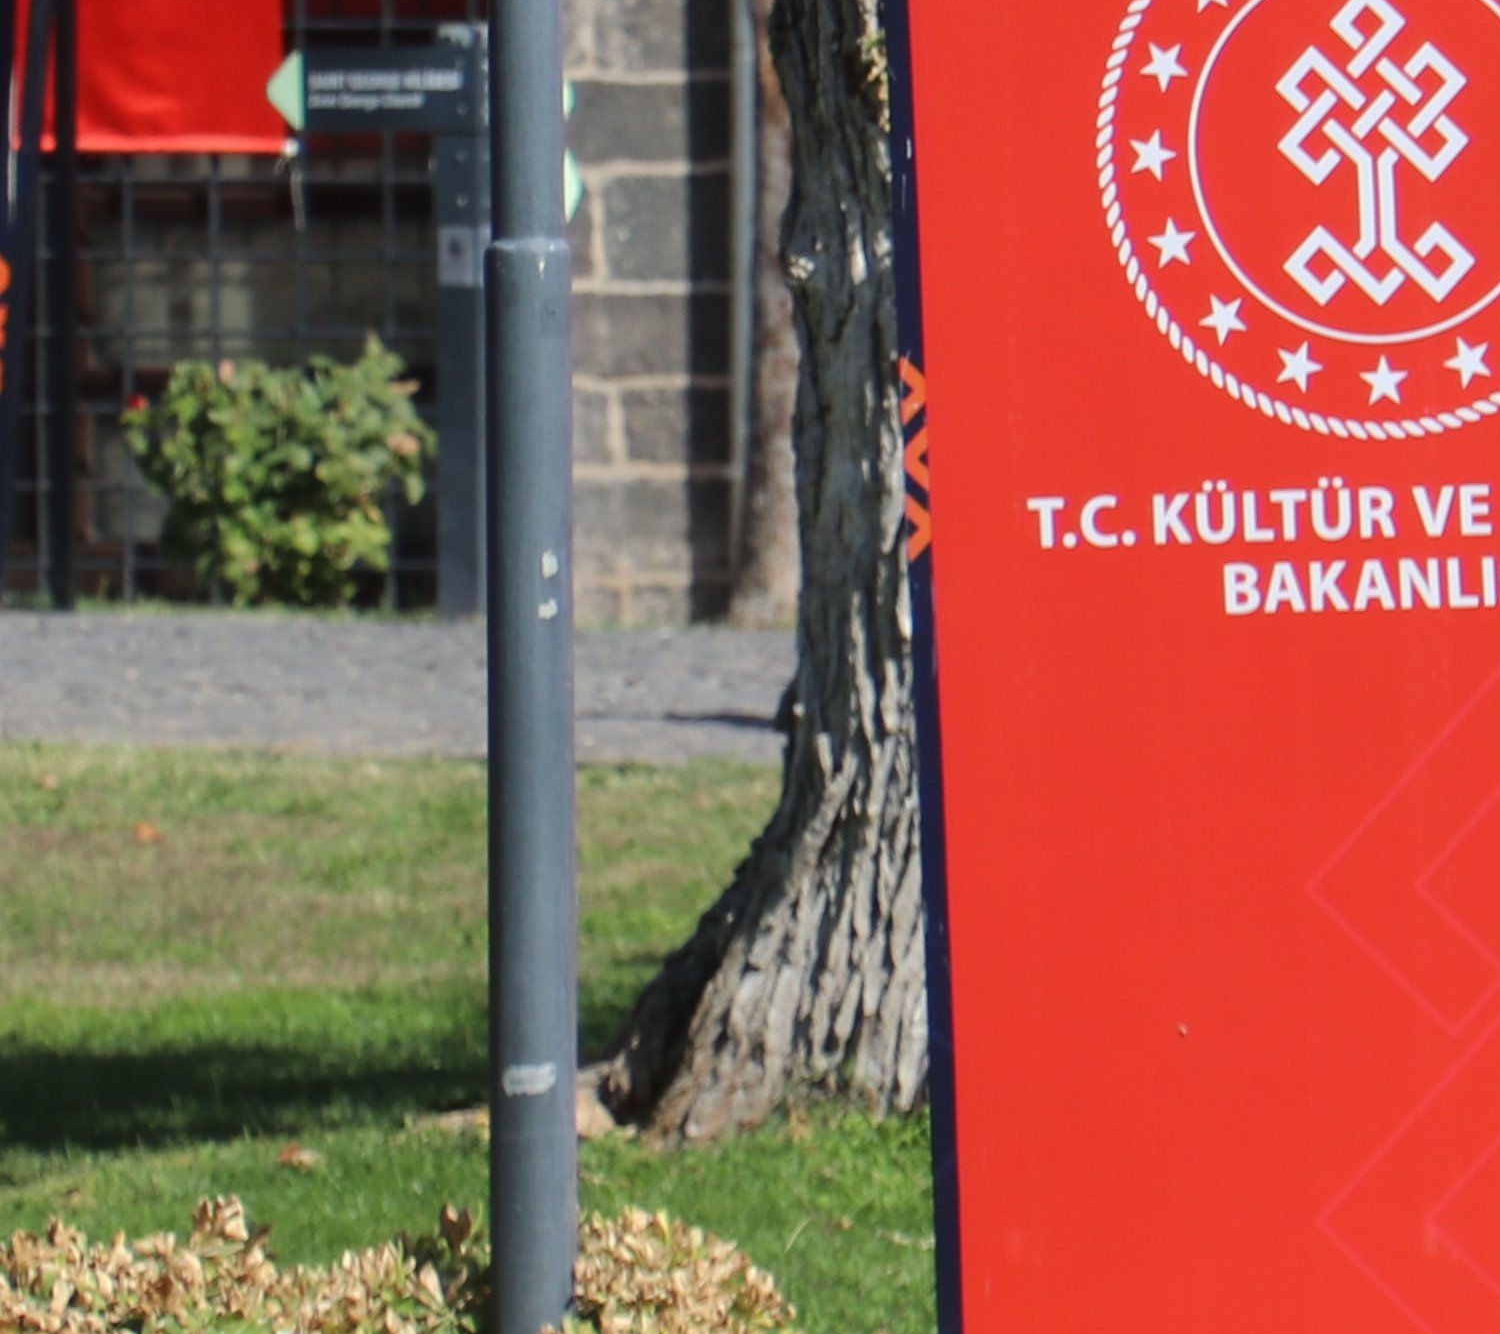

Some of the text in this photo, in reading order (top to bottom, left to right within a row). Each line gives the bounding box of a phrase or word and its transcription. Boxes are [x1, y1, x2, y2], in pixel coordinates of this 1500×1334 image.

[1026, 493, 1137, 550] T.C.
[1151, 476, 1397, 544] KÜLTÜR
[1411, 482, 1494, 538] VE
